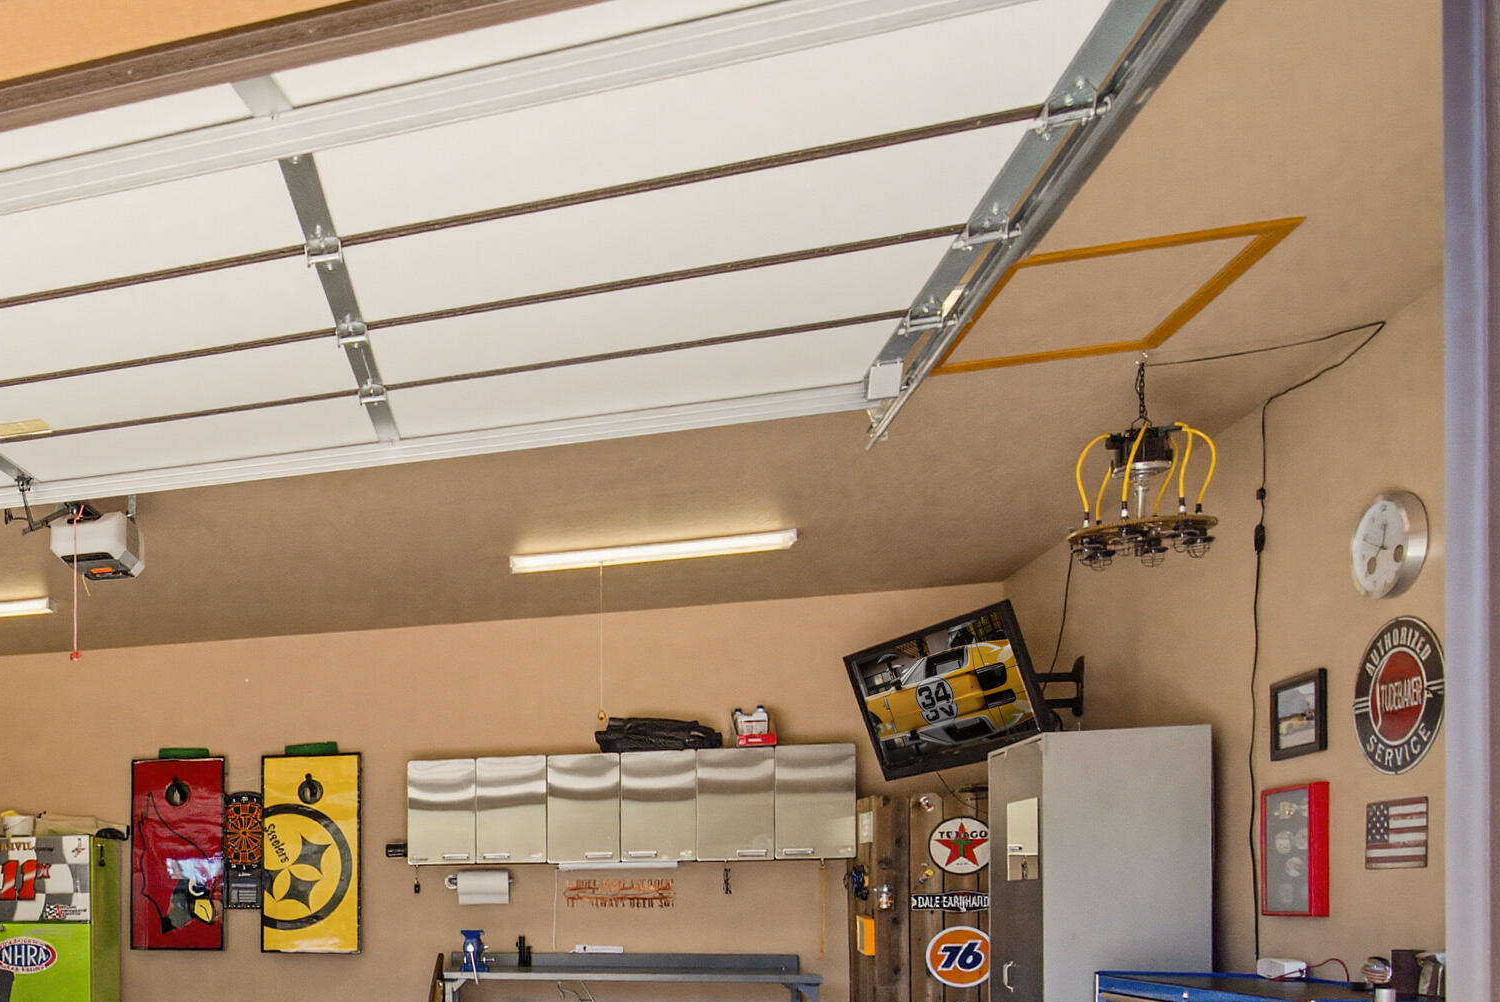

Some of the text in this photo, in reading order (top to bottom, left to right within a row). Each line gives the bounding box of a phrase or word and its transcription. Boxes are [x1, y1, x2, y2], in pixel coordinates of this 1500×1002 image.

[1365, 627, 1432, 676] AUTHORIZED
[918, 681, 951, 710] 34
[1366, 723, 1431, 767] SERVICE
[265, 823, 290, 864] Steelers
[939, 830, 988, 839] TEXACO
[918, 895, 989, 908] DALE EARNHARD
[1, 944, 47, 966] NHRA
[938, 941, 984, 972] 76
